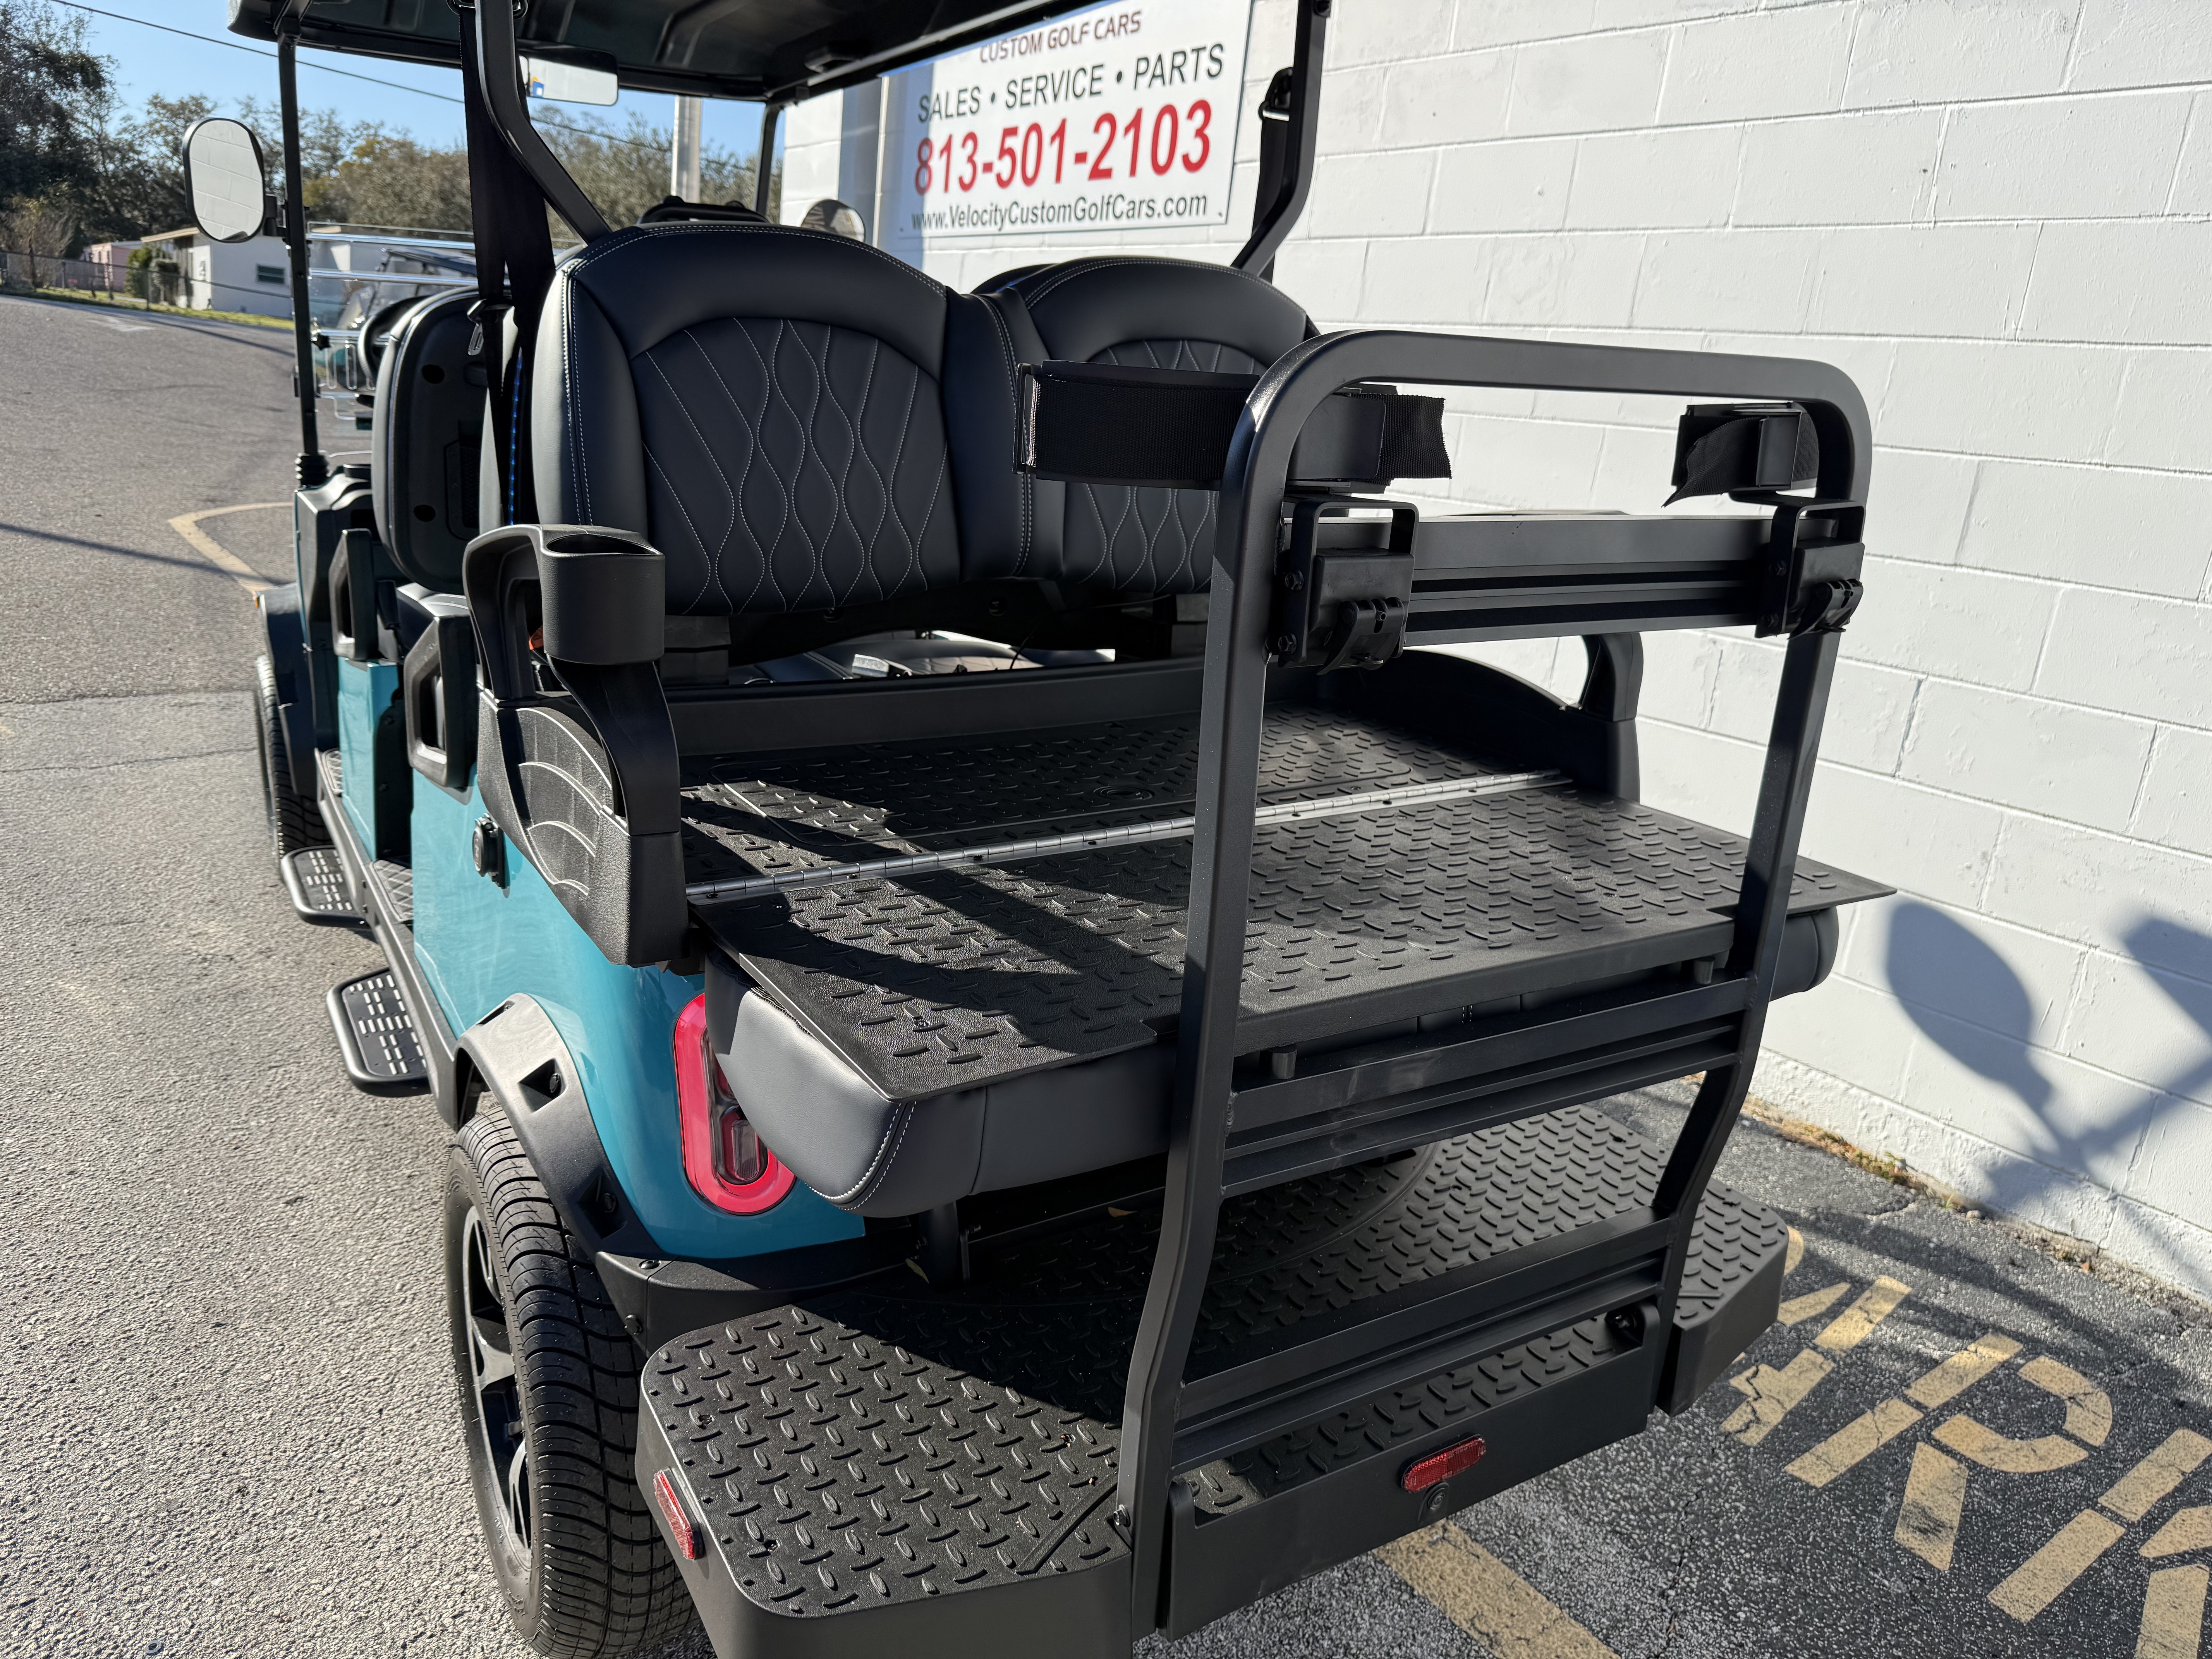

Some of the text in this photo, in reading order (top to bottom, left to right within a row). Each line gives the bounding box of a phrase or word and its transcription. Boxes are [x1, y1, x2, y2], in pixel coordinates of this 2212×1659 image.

[980, 10, 1142, 63] CUSTOM GOLF CARS
[918, 43, 1224, 123] SALES SERVICE PARTS
[914, 99, 1212, 197] 813-501-2103
[911, 194, 1207, 232] www.VelocityCustomGolfCars.com
